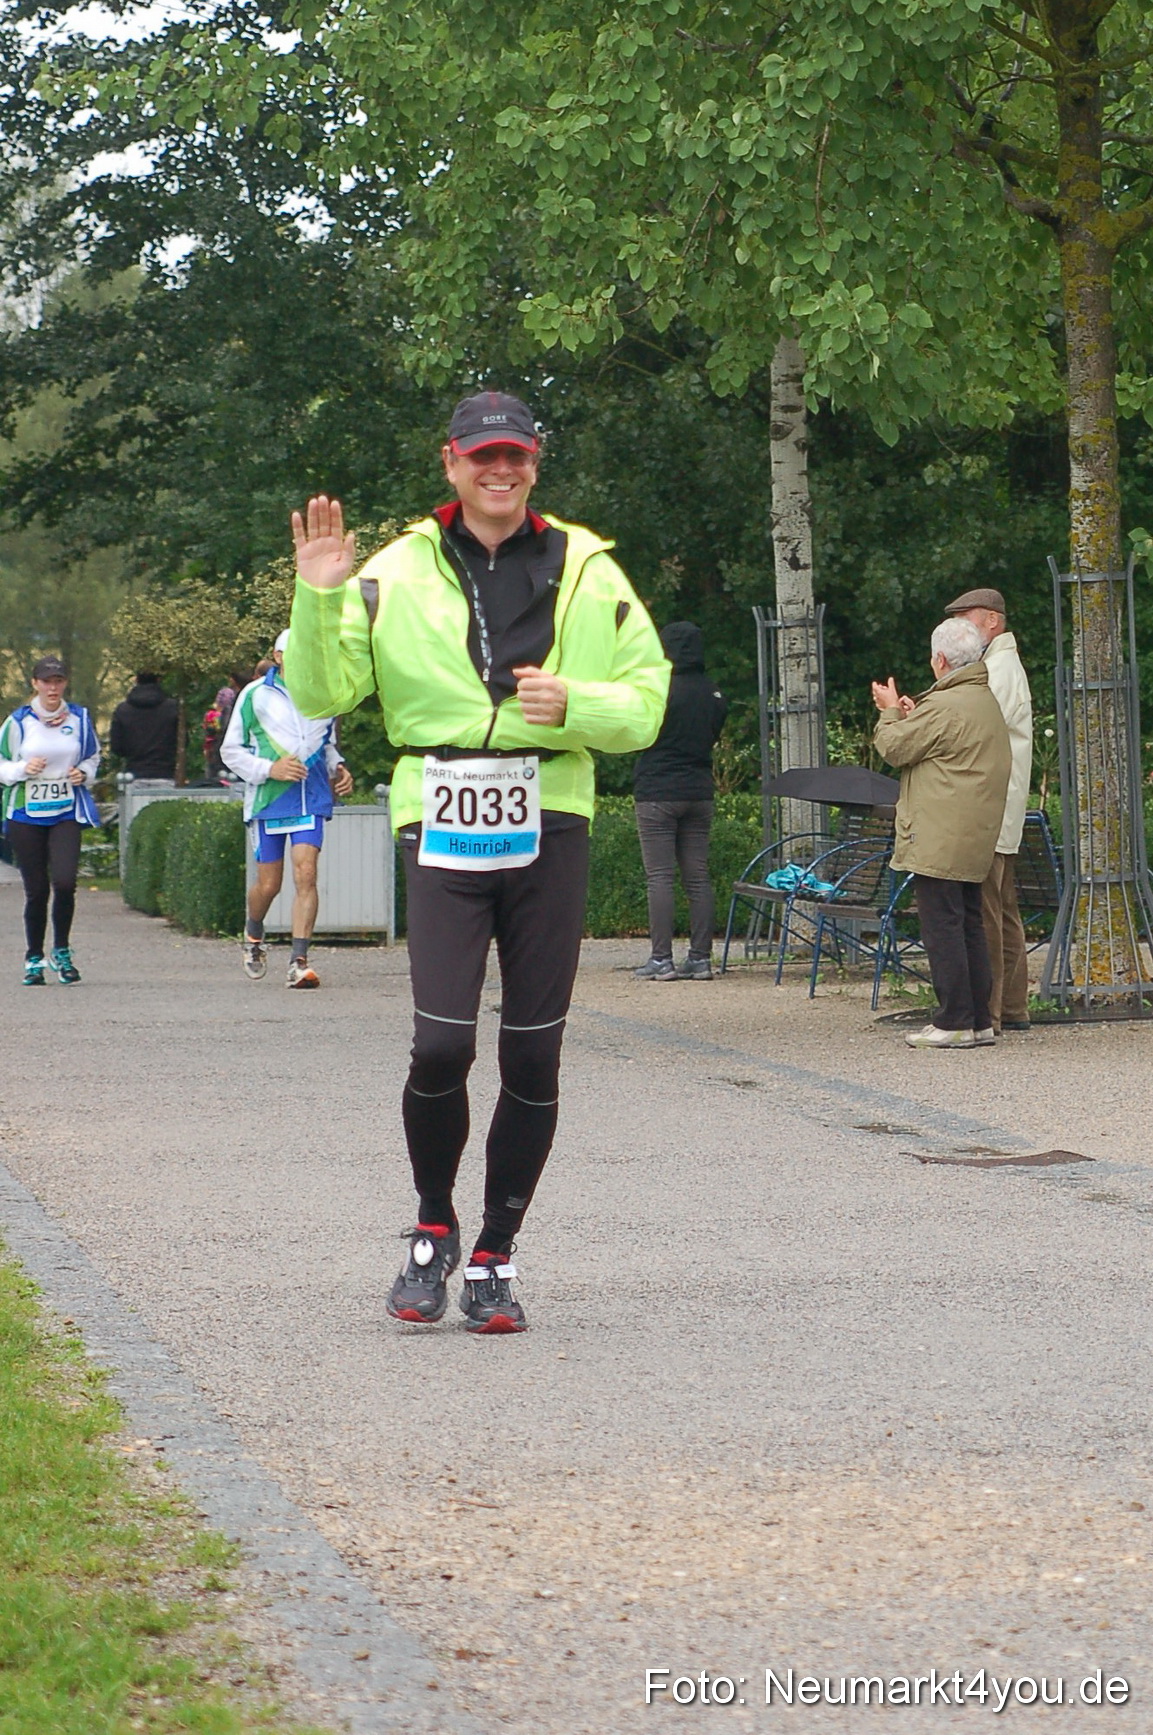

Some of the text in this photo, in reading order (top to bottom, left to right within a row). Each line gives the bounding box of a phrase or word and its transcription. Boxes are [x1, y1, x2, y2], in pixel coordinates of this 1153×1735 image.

[463, 771, 518, 781] Neumarkt
[31, 782, 68, 800] 2794
[435, 785, 528, 827] 2033
[449, 837, 511, 855] Heinrich
